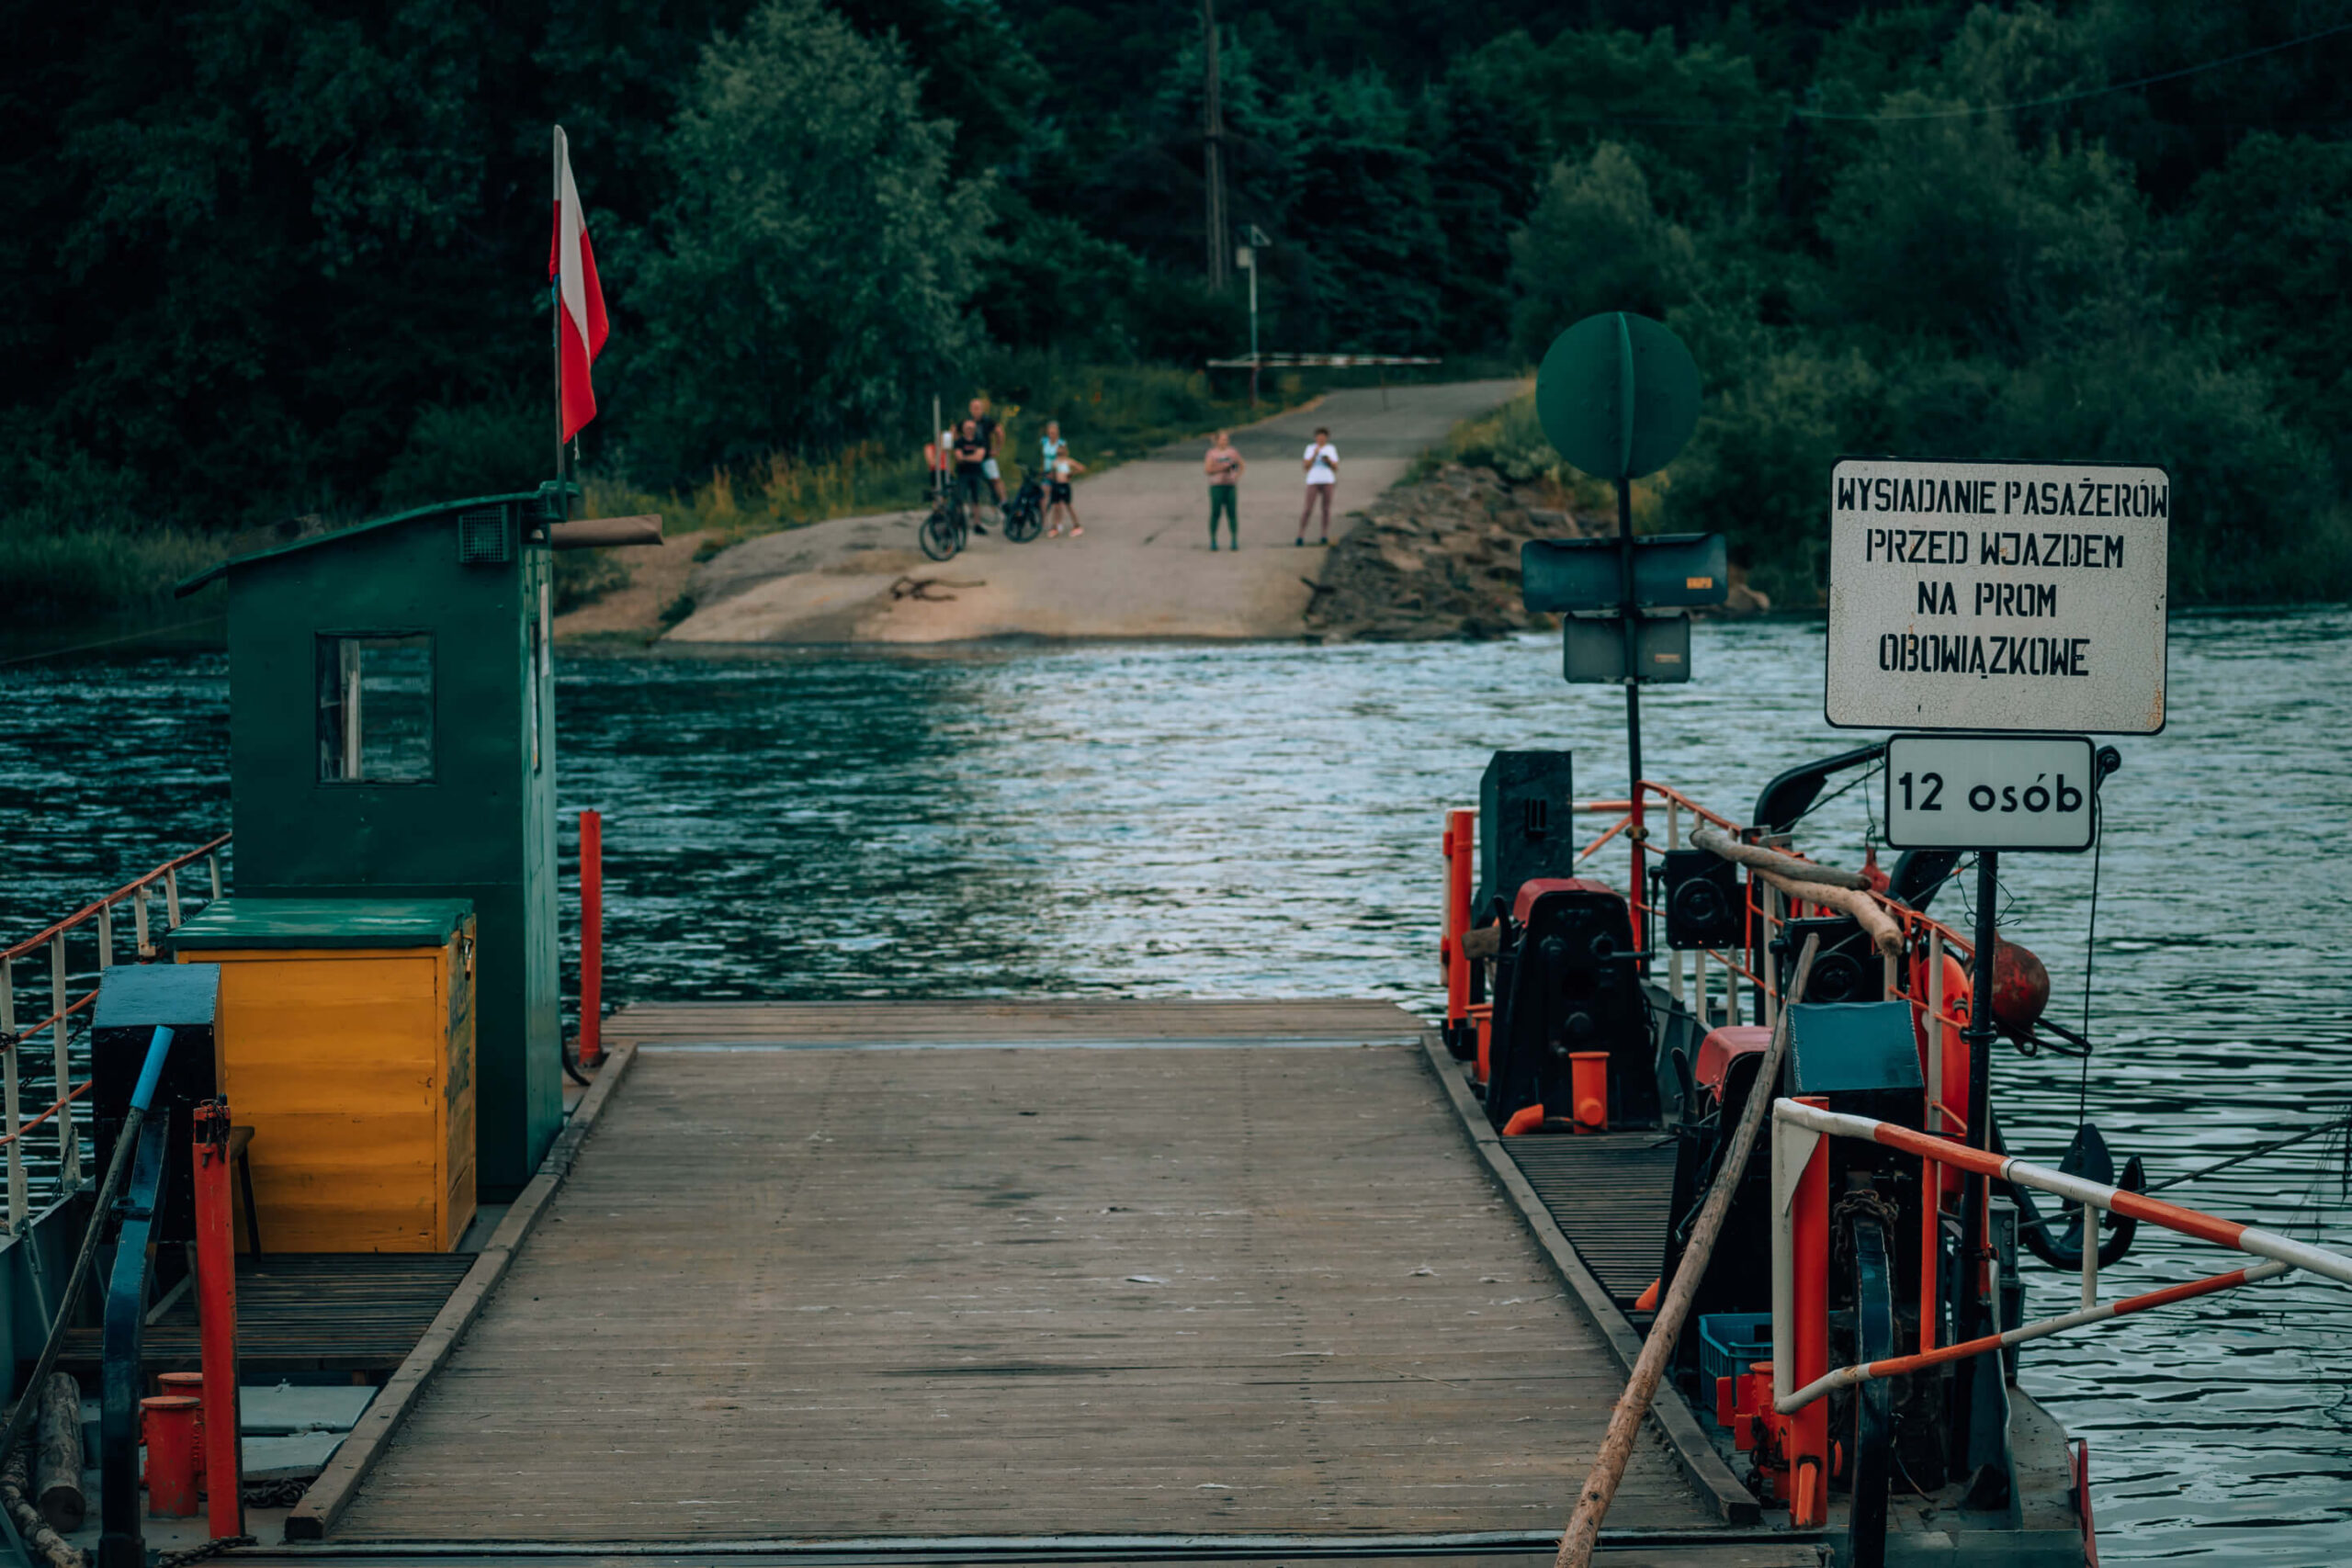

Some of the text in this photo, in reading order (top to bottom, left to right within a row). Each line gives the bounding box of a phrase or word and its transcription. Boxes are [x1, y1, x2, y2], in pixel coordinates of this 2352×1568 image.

[1838, 478, 2167, 517] WYSIADANIE PASAŻERÓW
[1867, 529, 2124, 568] PRZED WJAZDEM
[1918, 581, 2056, 617] NA PROM
[1880, 634, 2090, 679] OBOWIĄZKOWE
[1899, 773, 2082, 812] 12 osób
